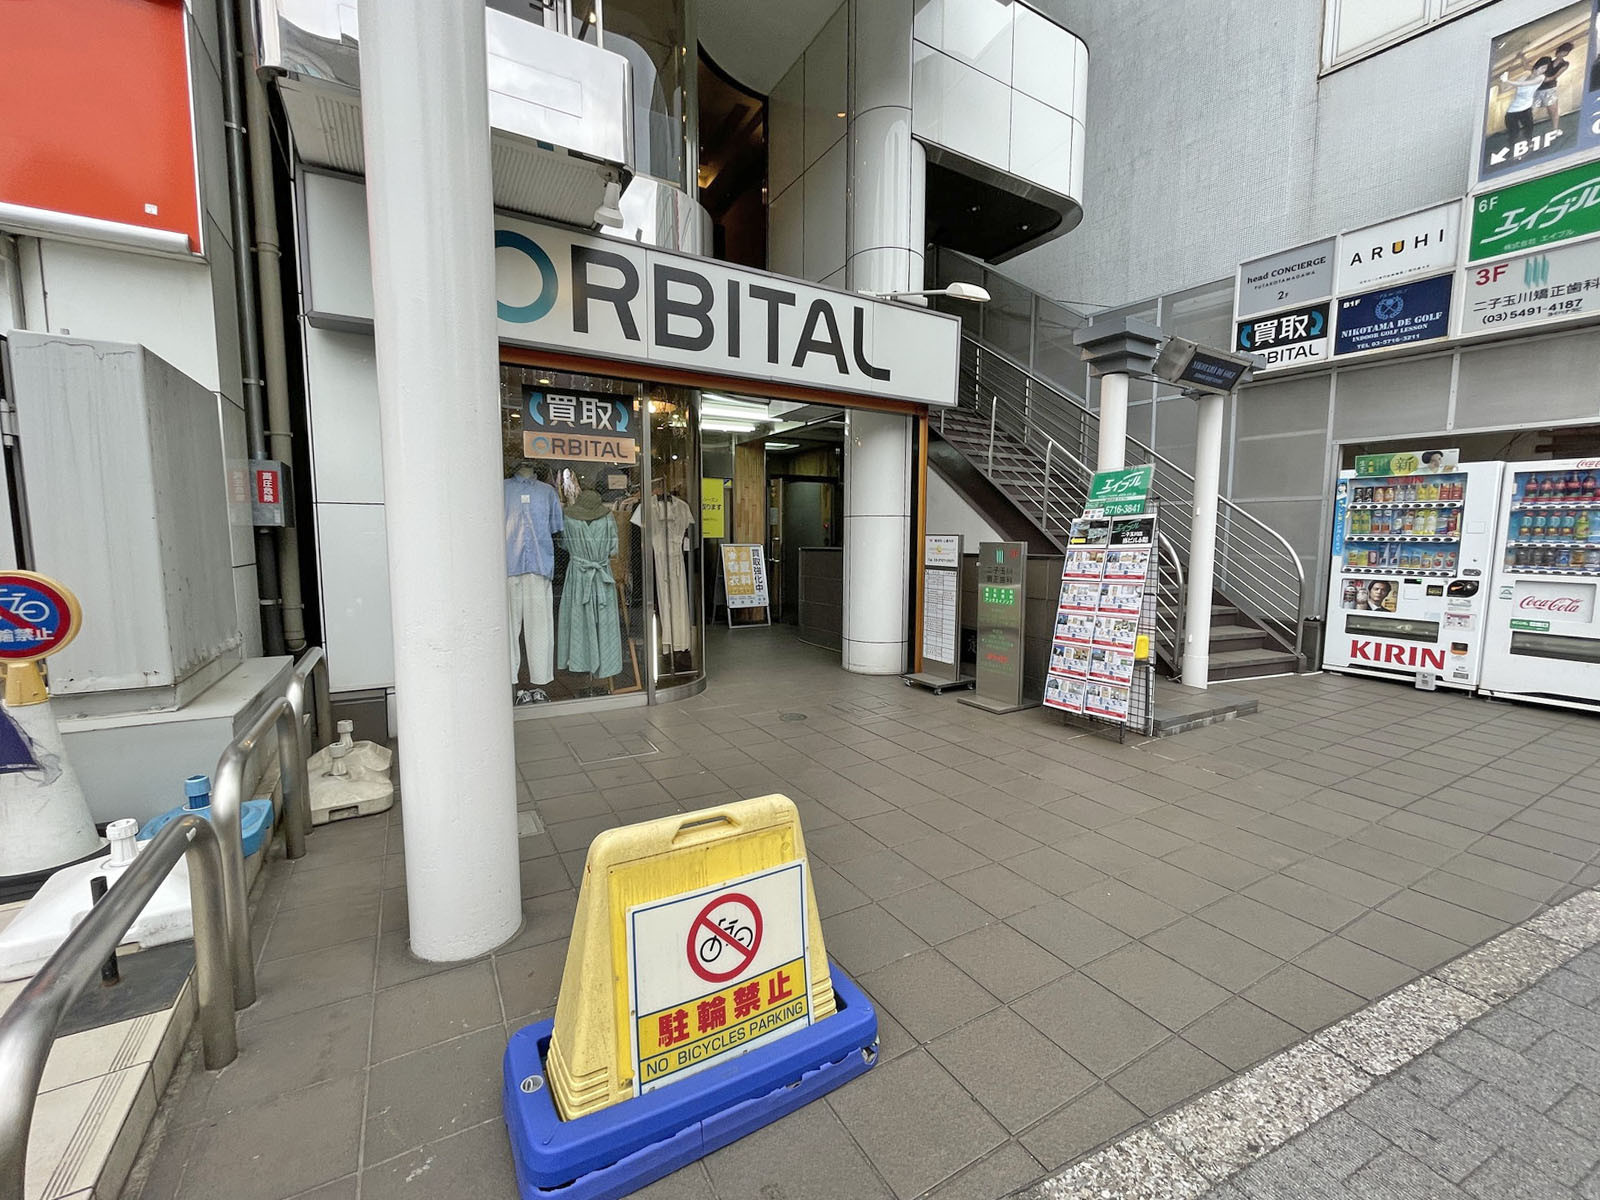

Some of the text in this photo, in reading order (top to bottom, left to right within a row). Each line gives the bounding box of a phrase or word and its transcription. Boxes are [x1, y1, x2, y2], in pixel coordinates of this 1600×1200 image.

[1513, 129, 1563, 158] B1F
[1478, 196, 1498, 213] 6F
[1350, 229, 1444, 266] ARUHI
[1247, 256, 1327, 284] head CONCIERGE
[1475, 264, 1509, 286] 3F
[495, 230, 891, 382] ORBITAL
[1343, 299, 1361, 309] B1F
[1473, 277, 1600, 312] 二子玉川矯正歯科
[1254, 314, 1309, 347] 買取
[1341, 311, 1443, 338] NIKOTAMA DE GOLF
[1352, 323, 1428, 342] INDOOR GOLF LESSON
[1258, 344, 1319, 364] BITAL
[546, 393, 613, 431] 買取
[531, 436, 629, 459] ORBITAL
[1395, 456, 1414, 472] 新
[1098, 471, 1144, 493] エイブル
[1350, 639, 1446, 670] KIRIN
[658, 971, 792, 1047] 駐輪禁止
[646, 1001, 803, 1077] NO BICYCLES PARKING
